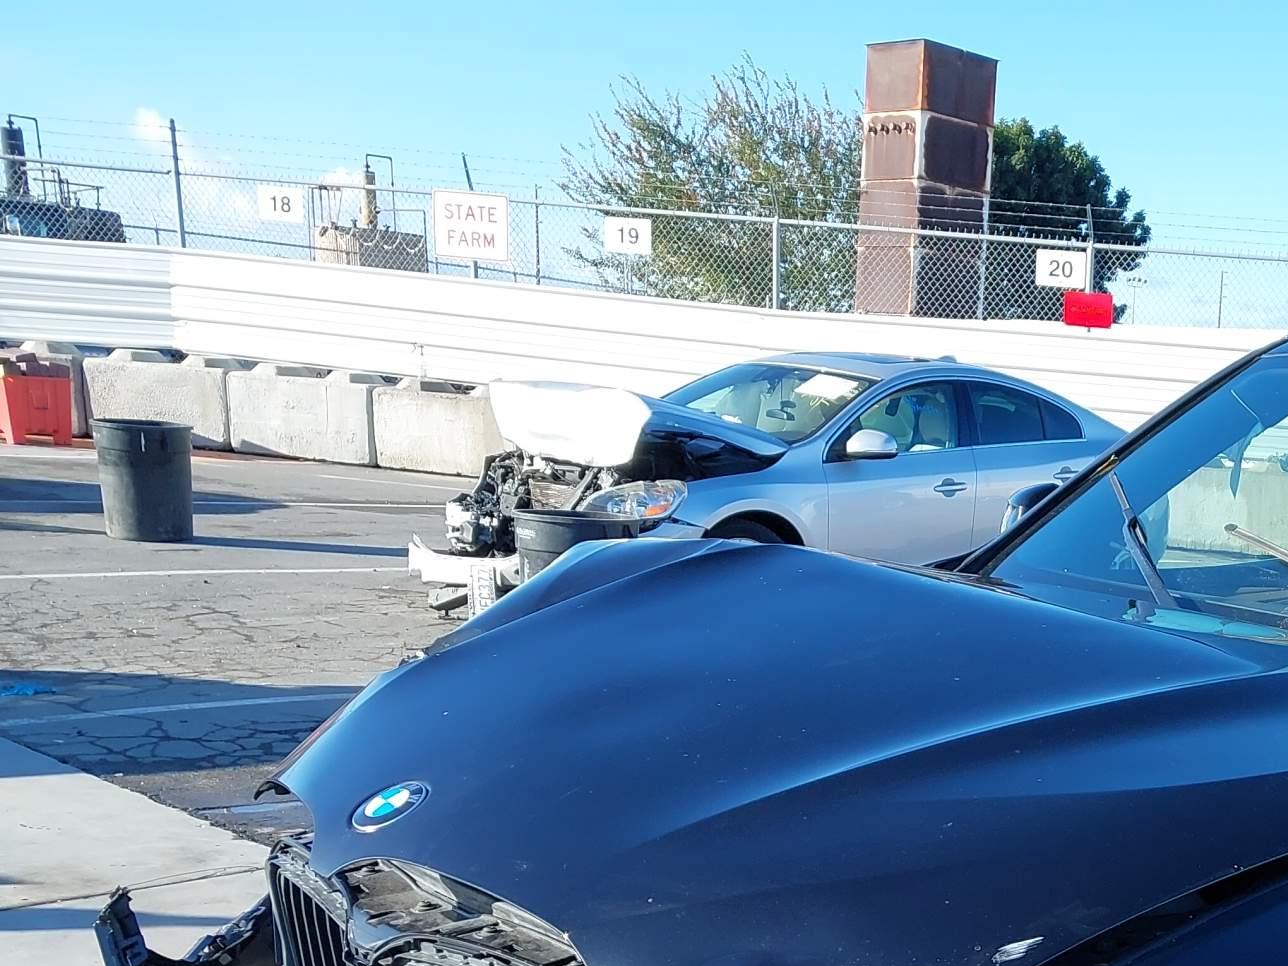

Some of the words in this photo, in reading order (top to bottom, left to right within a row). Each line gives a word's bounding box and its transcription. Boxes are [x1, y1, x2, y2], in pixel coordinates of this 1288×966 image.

[269, 195, 291, 213] 18
[444, 203, 497, 223] STATE
[447, 229, 495, 249] FARM
[616, 226, 639, 244] 19
[1048, 259, 1073, 278] 20
